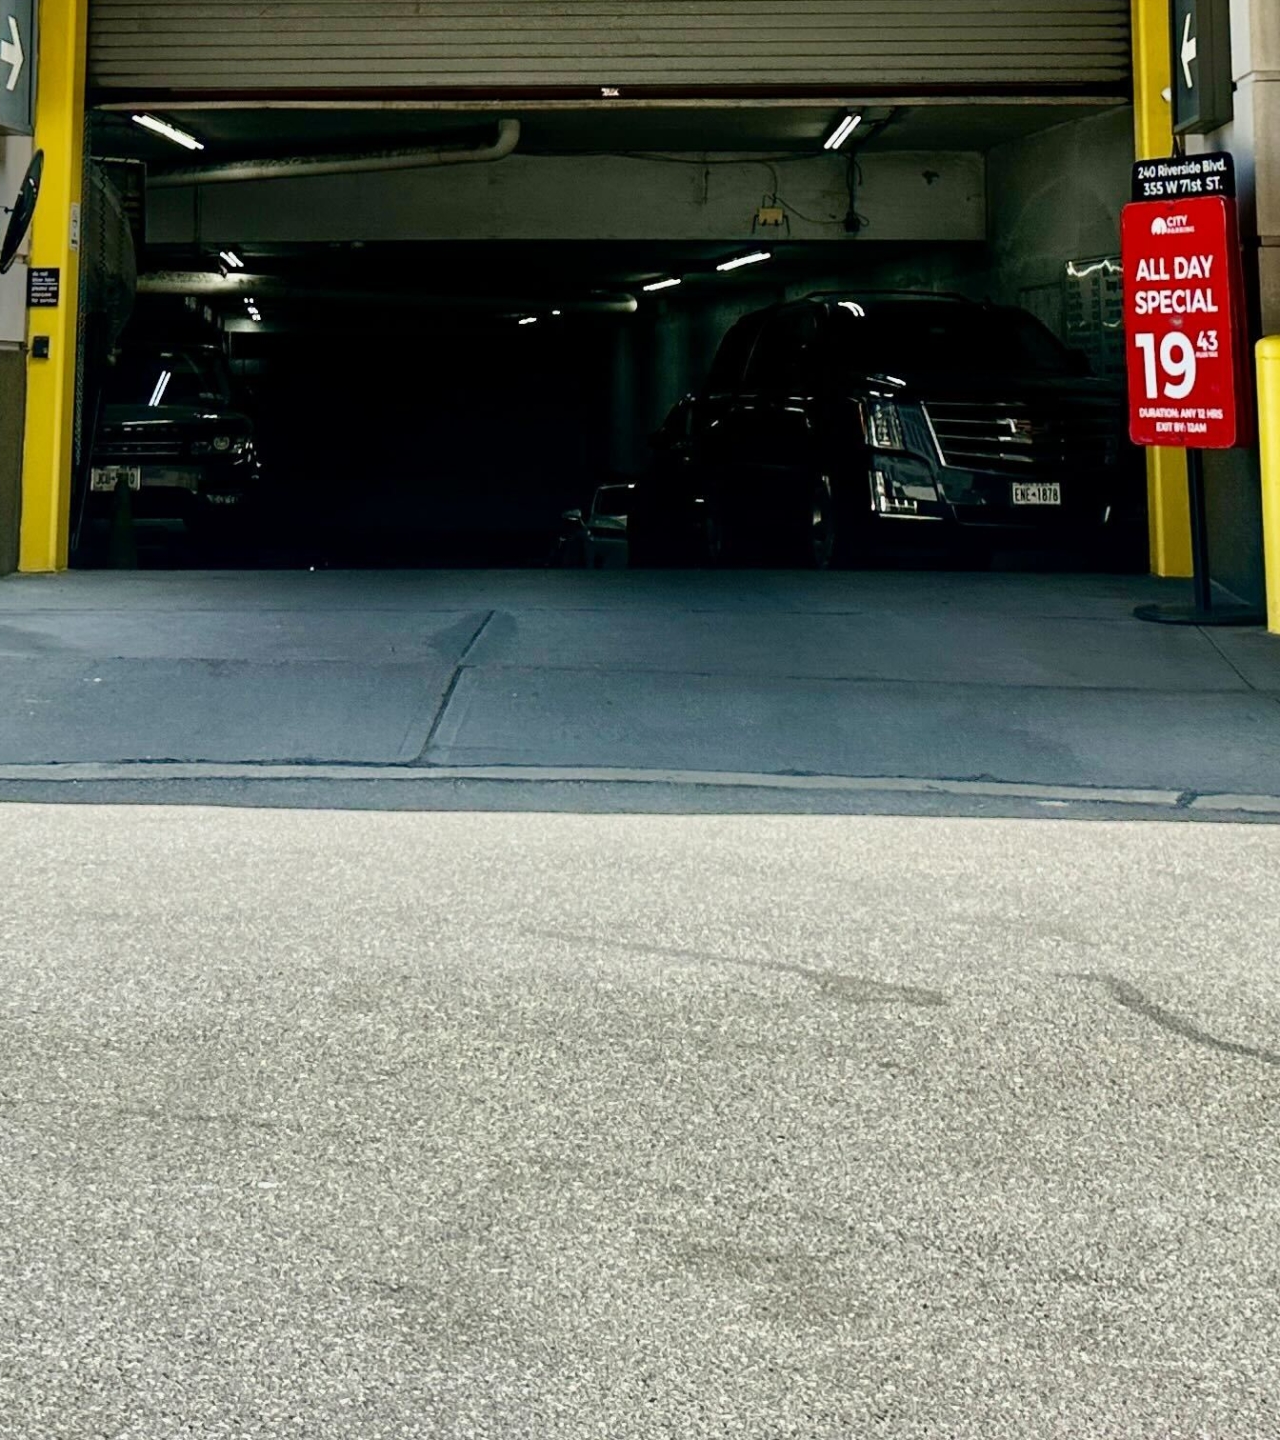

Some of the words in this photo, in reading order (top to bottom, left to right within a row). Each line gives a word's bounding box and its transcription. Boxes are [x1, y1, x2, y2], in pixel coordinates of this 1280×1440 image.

[1137, 164, 1157, 180] 240
[1157, 161, 1201, 178] Riverside
[1143, 180, 1164, 196] 355
[1165, 179, 1178, 194] W
[1179, 178, 1203, 193] 71st
[1166, 214, 1188, 227] CITY
[1135, 257, 1170, 282] ALL
[1173, 254, 1214, 280] DAY
[1134, 287, 1219, 315] SPECIAL
[1134, 331, 1197, 400] 19
[1196, 329, 1219, 352] 43
